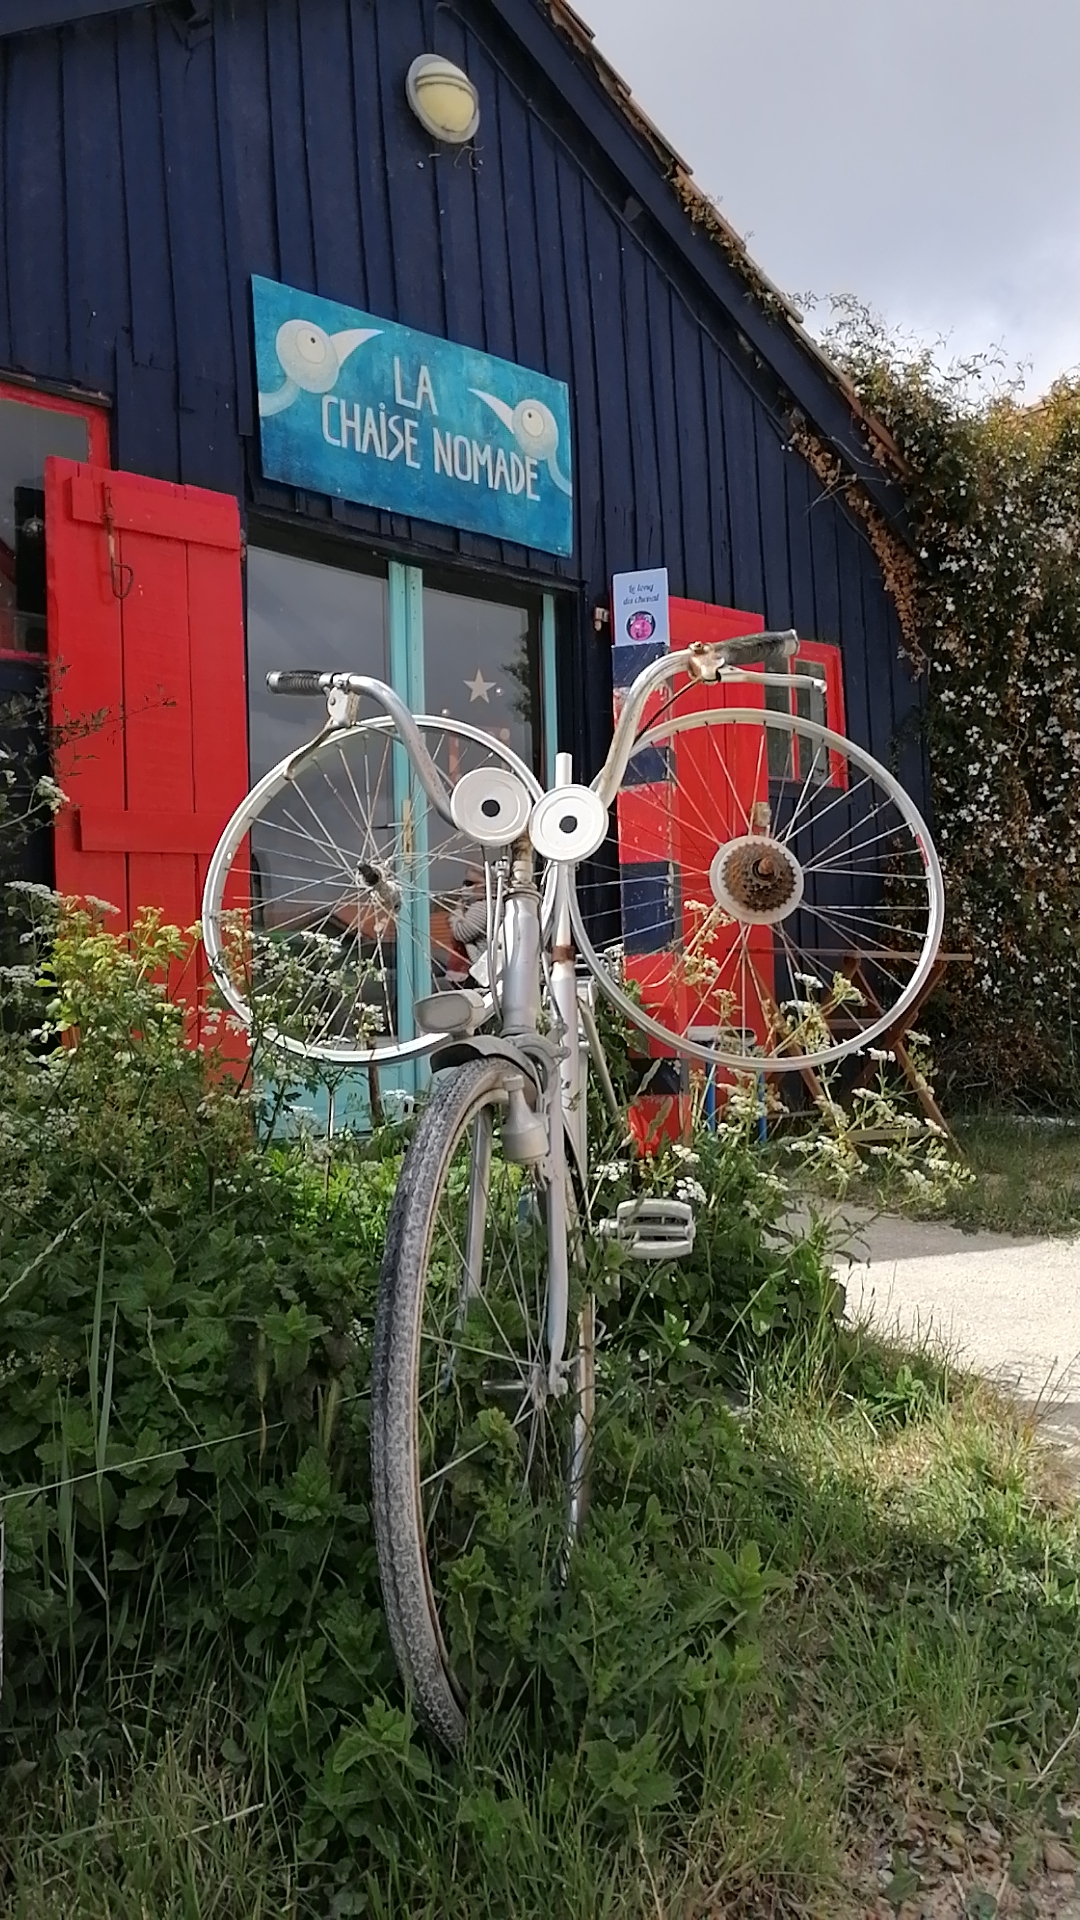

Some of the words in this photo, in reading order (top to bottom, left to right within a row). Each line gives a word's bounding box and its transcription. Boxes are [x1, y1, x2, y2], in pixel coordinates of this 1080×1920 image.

[393, 355, 439, 416] LA
[433, 427, 541, 502] NOMADE
[623, 596, 633, 605] du
[637, 583, 654, 593] long
